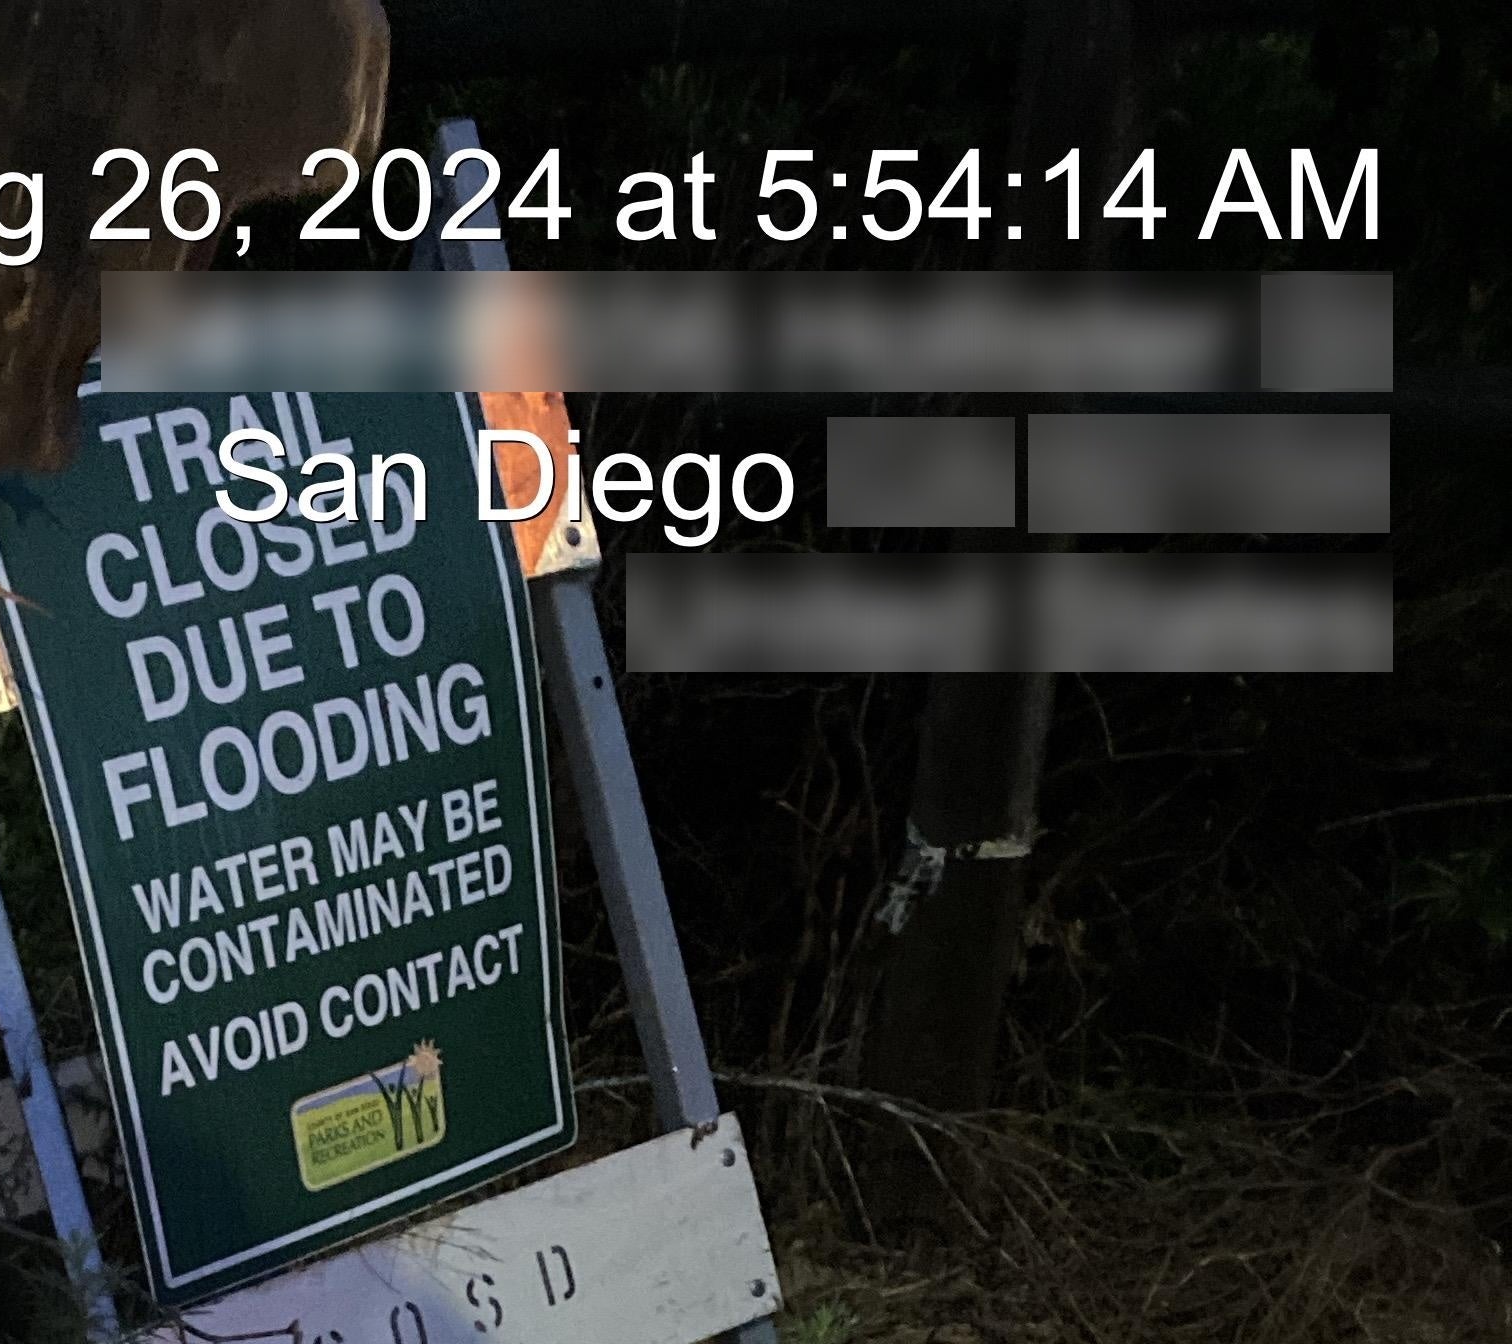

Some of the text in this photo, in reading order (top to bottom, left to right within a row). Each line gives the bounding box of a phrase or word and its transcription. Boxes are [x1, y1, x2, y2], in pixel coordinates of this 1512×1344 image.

[99, 391, 354, 502] TRAIL
[85, 470, 417, 619] CLOSED
[126, 574, 426, 722] DUE TO
[102, 663, 491, 842] FLOODING
[132, 779, 503, 934] WATER MAY BE
[142, 844, 513, 1005] CONTAMINATED
[160, 923, 525, 1096] AVOID CONTACT
[308, 1120, 350, 1149] PARKS
[352, 1109, 384, 1137] AND
